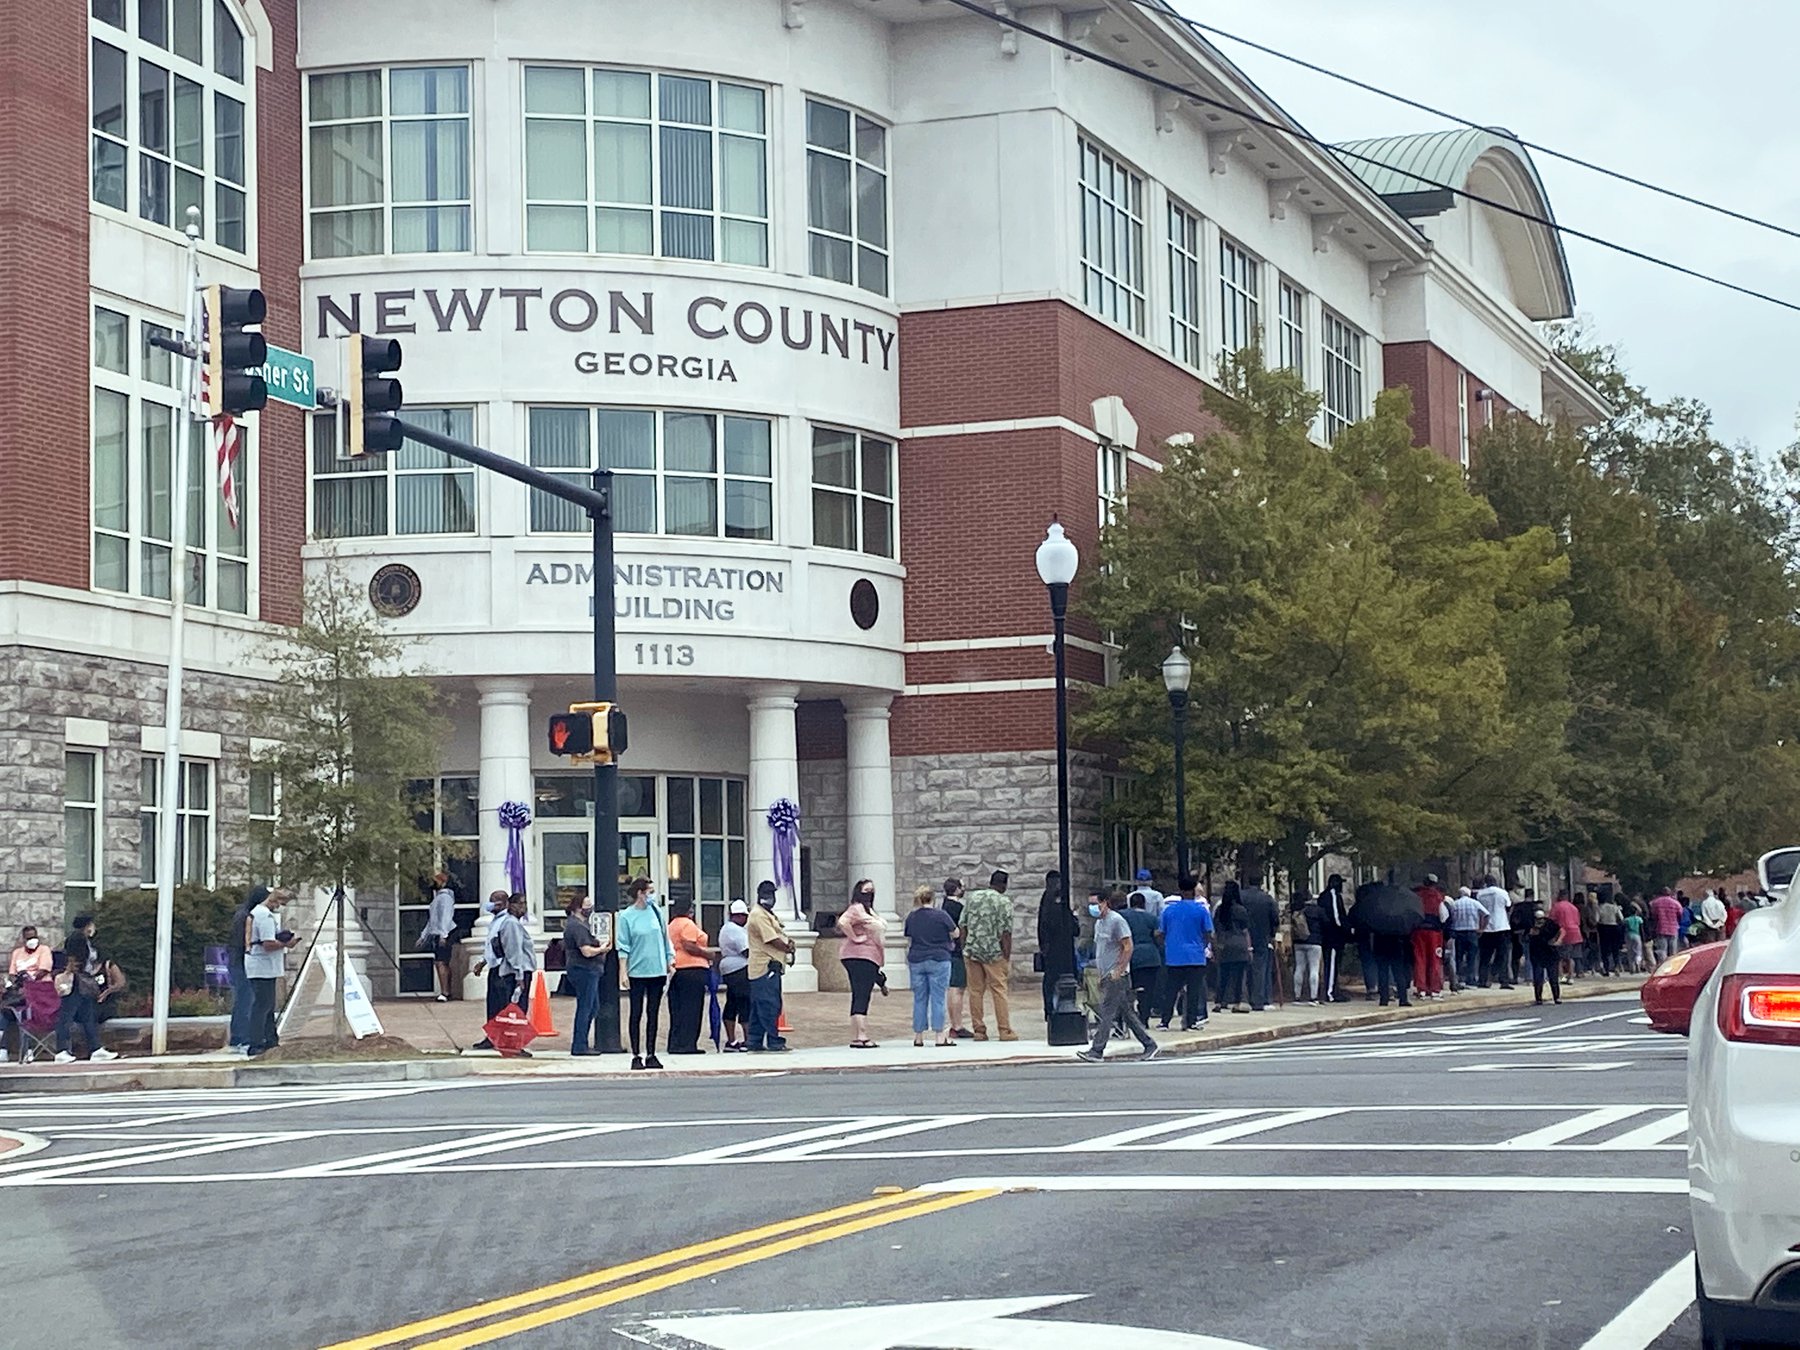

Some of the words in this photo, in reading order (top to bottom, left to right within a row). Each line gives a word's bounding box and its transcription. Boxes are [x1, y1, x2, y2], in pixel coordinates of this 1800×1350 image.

[317, 287, 654, 338] NEWTON
[687, 296, 895, 371] COUNTY
[292, 366, 310, 396] St
[574, 351, 738, 382] GEORGIA
[526, 563, 784, 593] ADMNISTRATION
[635, 643, 695, 666] 1113
